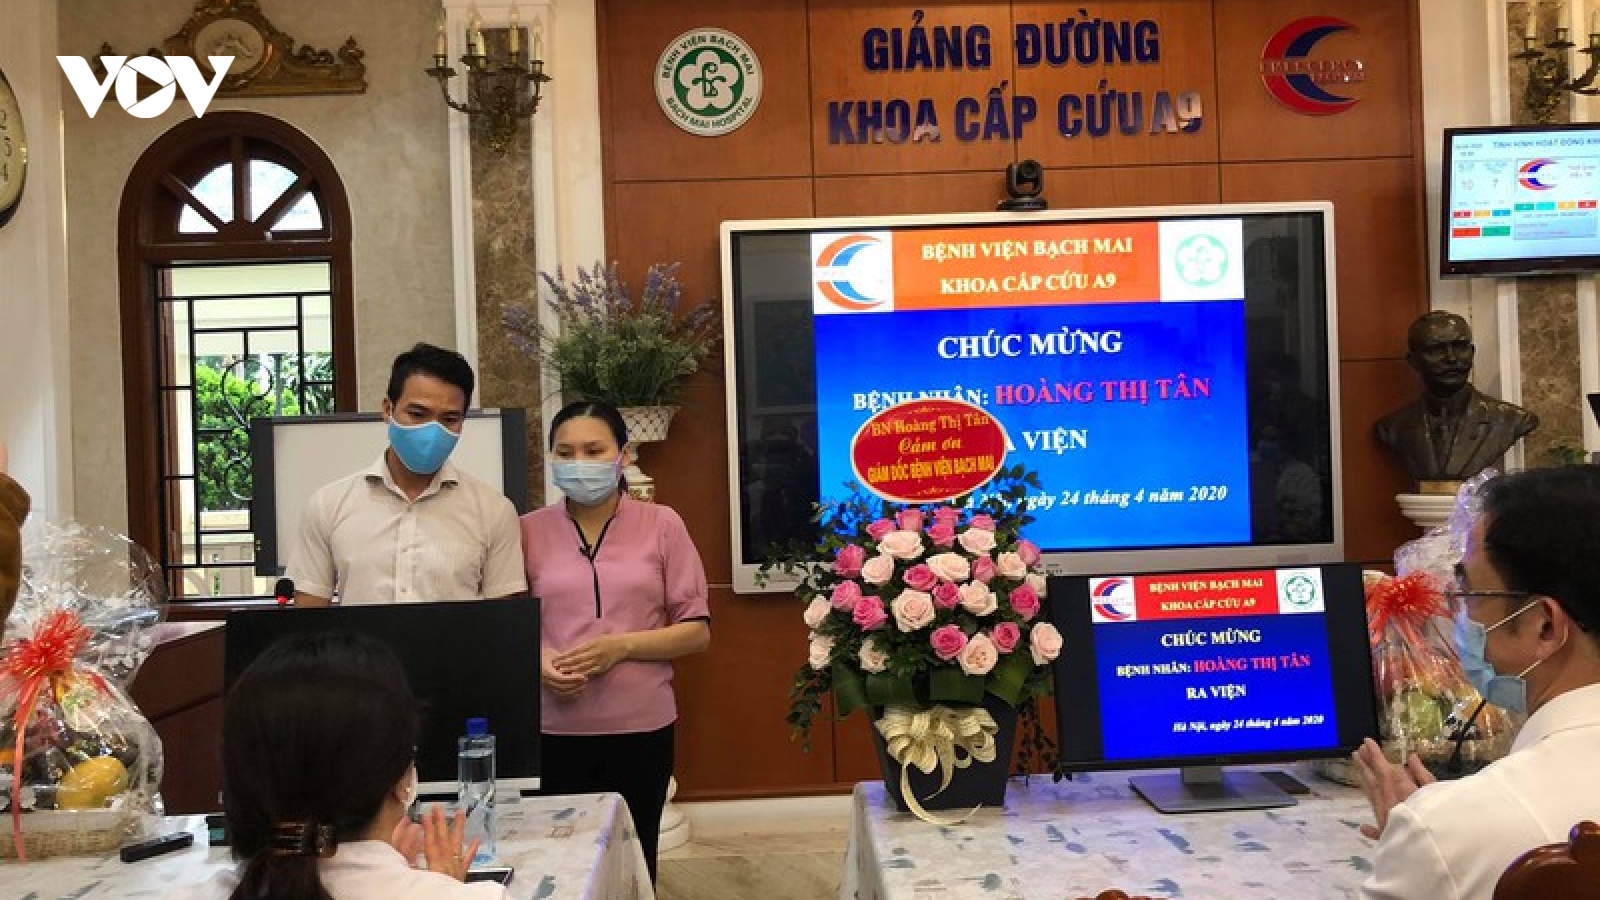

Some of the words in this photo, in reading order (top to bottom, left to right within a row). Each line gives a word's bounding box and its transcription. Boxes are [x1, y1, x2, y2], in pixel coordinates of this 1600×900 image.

[863, 10, 991, 74] GIẢNG
[1015, 9, 1160, 70] ĐƯỜNG
[829, 100, 942, 145] KHOA
[955, 80, 1037, 143] CẤP
[1057, 79, 1142, 138] CỨU
[1149, 91, 1204, 135] A9
[922, 244, 975, 263] BỆNH
[981, 242, 1028, 262] VIỆN
[1033, 239, 1087, 260] BẠCH
[1093, 237, 1133, 254] MAI
[940, 277, 999, 294] KHOA
[1093, 273, 1117, 289] A9
[938, 331, 1022, 360] CHÚC
[1030, 327, 1123, 357] MỪNG
[995, 378, 1094, 407] HOÀNG
[1100, 378, 1148, 405] THỊ
[1156, 372, 1212, 400] TÂN
[871, 421, 890, 437] BN
[938, 414, 962, 431] Thị
[1021, 427, 1088, 455] VIỆN
[978, 455, 995, 472] MAI
[1060, 490, 1082, 506] 24
[1083, 487, 1129, 508] tháng
[1133, 487, 1145, 504] 4
[1149, 487, 1184, 504] năm
[1187, 485, 1229, 502] 2020
[1241, 578, 1263, 590] MAI
[1160, 601, 1193, 612] KHOA
[1161, 629, 1207, 648] CHÚC
[1211, 627, 1262, 646] MỪNG
[1116, 664, 1150, 679] BỆNH
[1152, 660, 1192, 676] NHÂN:
[1193, 655, 1248, 674] HOÀNG
[1250, 655, 1277, 673] THỊ
[1186, 686, 1208, 700] RA
[1210, 683, 1246, 701] VIỆN
